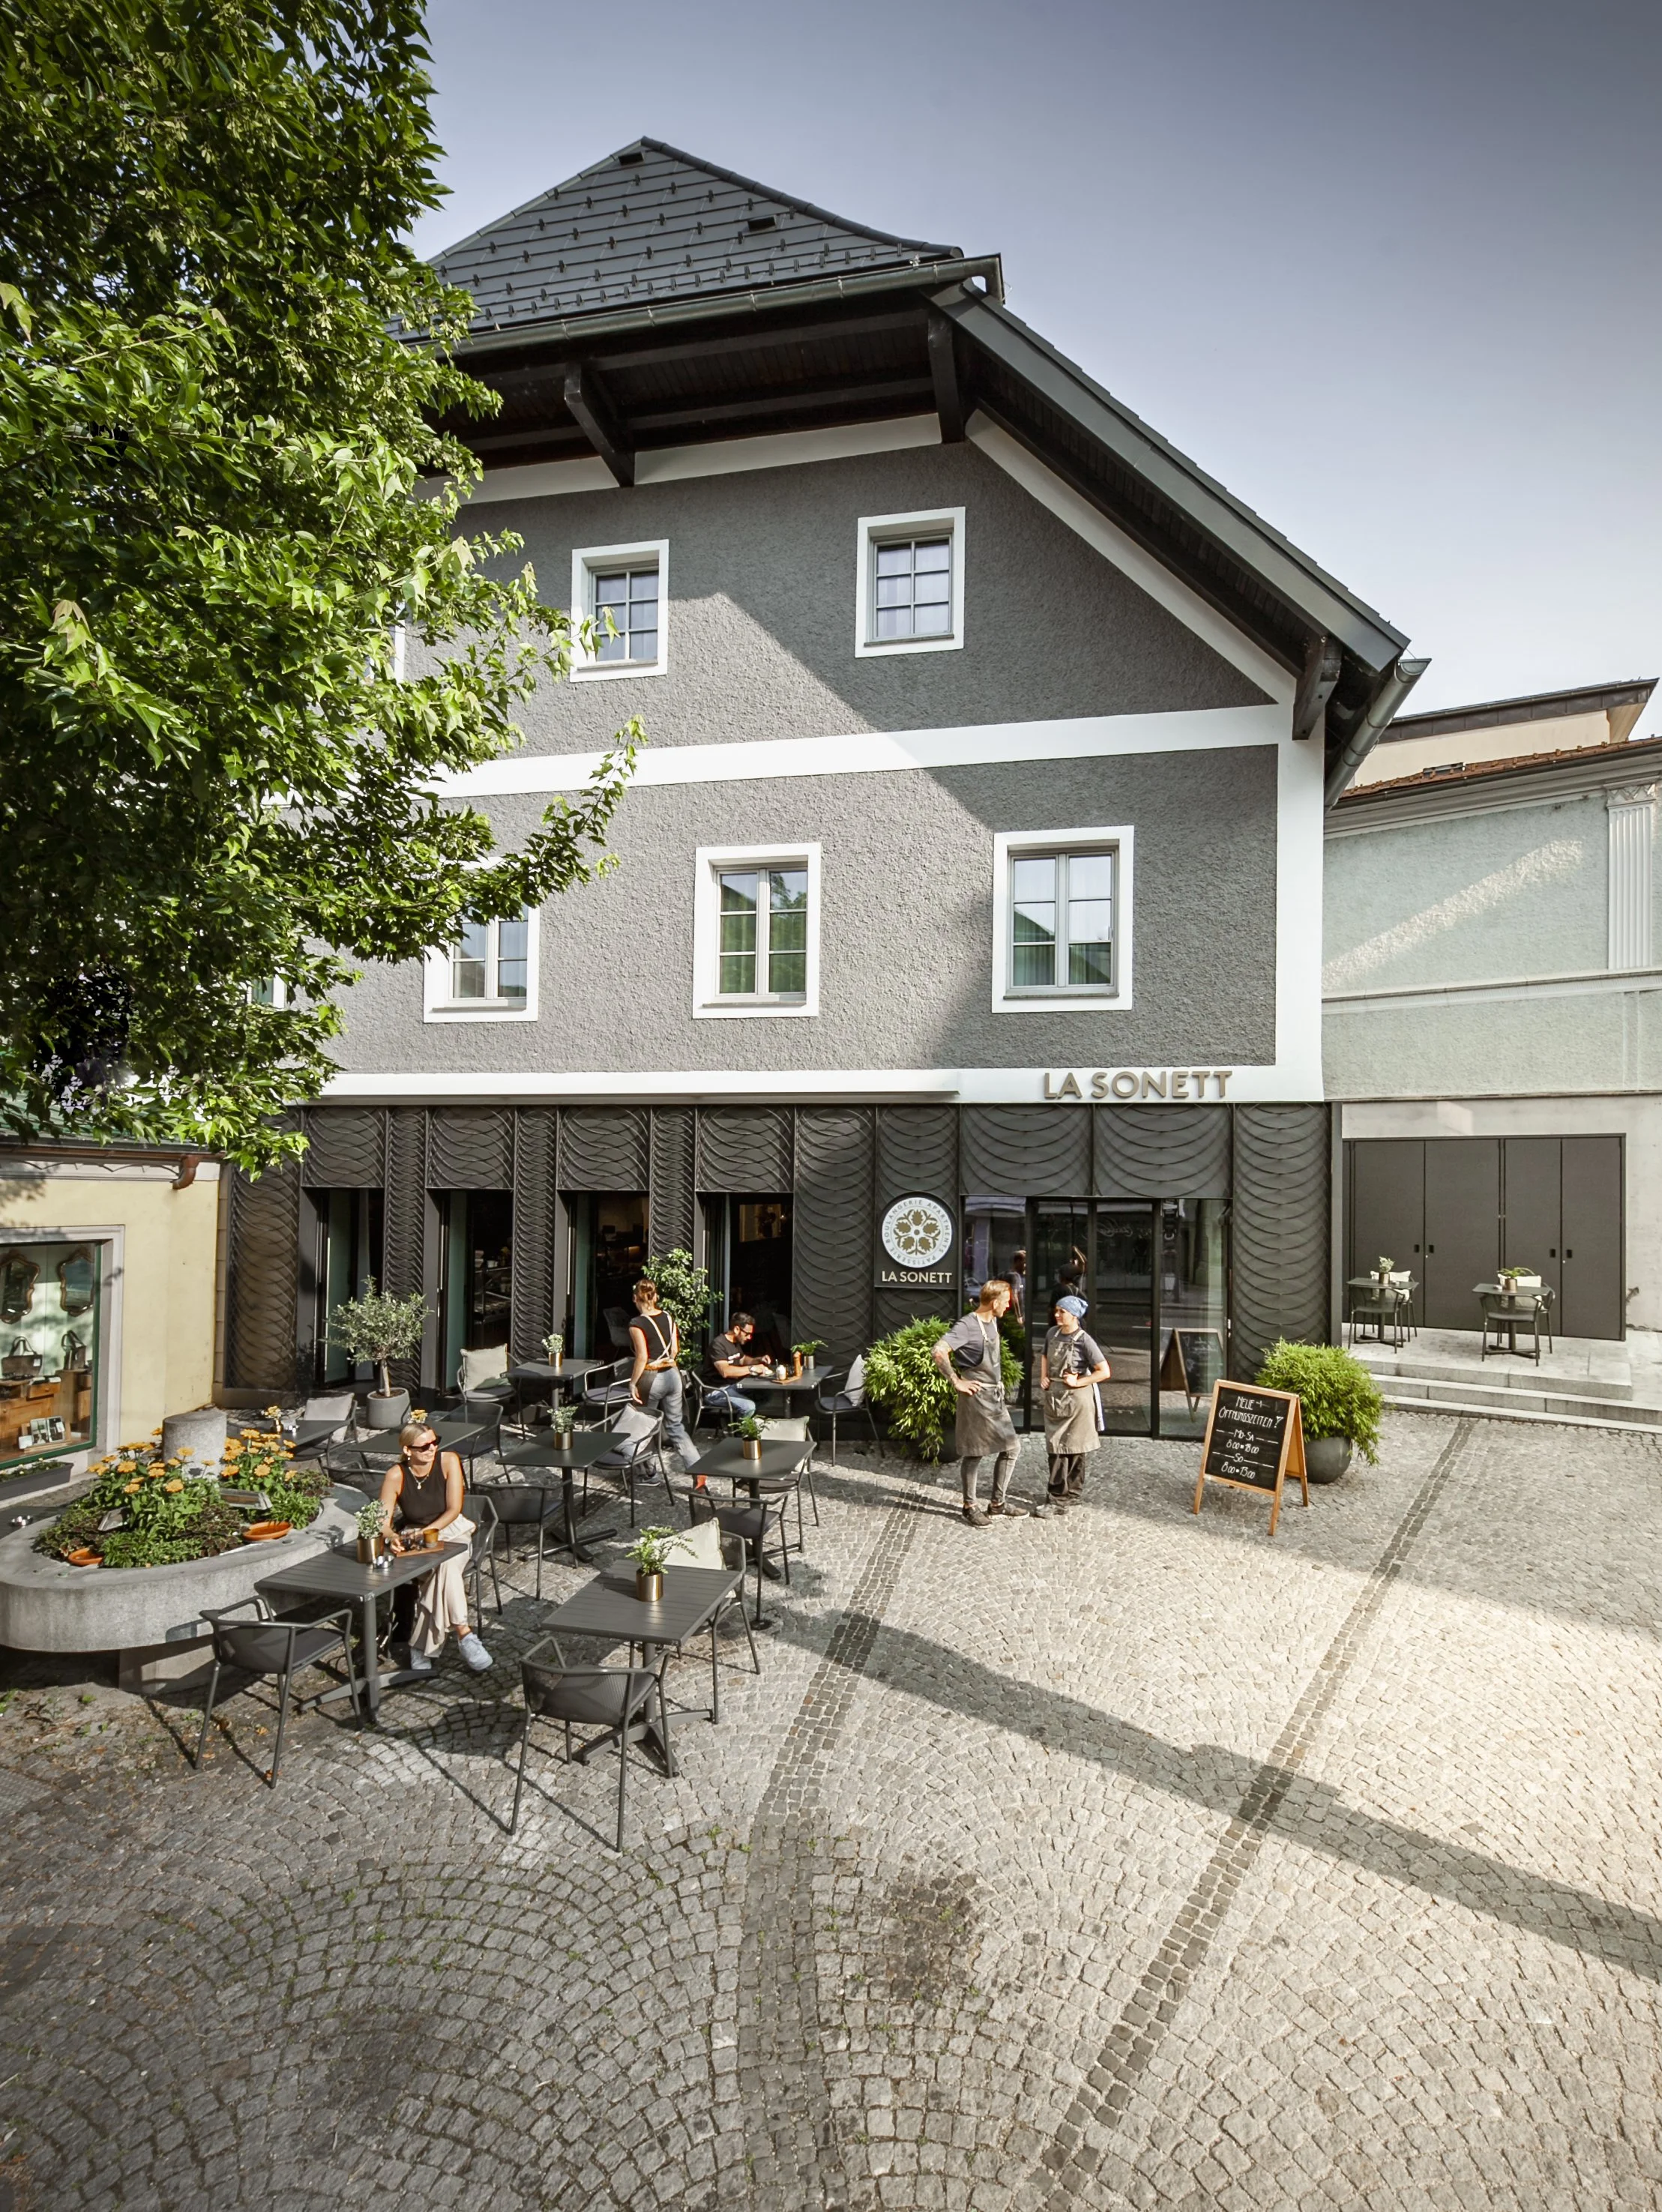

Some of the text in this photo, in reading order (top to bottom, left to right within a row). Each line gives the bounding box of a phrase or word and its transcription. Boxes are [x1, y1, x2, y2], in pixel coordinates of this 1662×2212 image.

[1043, 1070, 1232, 1099] LA SONETT
[884, 1199, 923, 1244] BOULANGERIE
[927, 1202, 950, 1253] APARTMENTS
[882, 1271, 952, 1283] LA SONETT
[1235, 1396, 1255, 1411] NEUE
